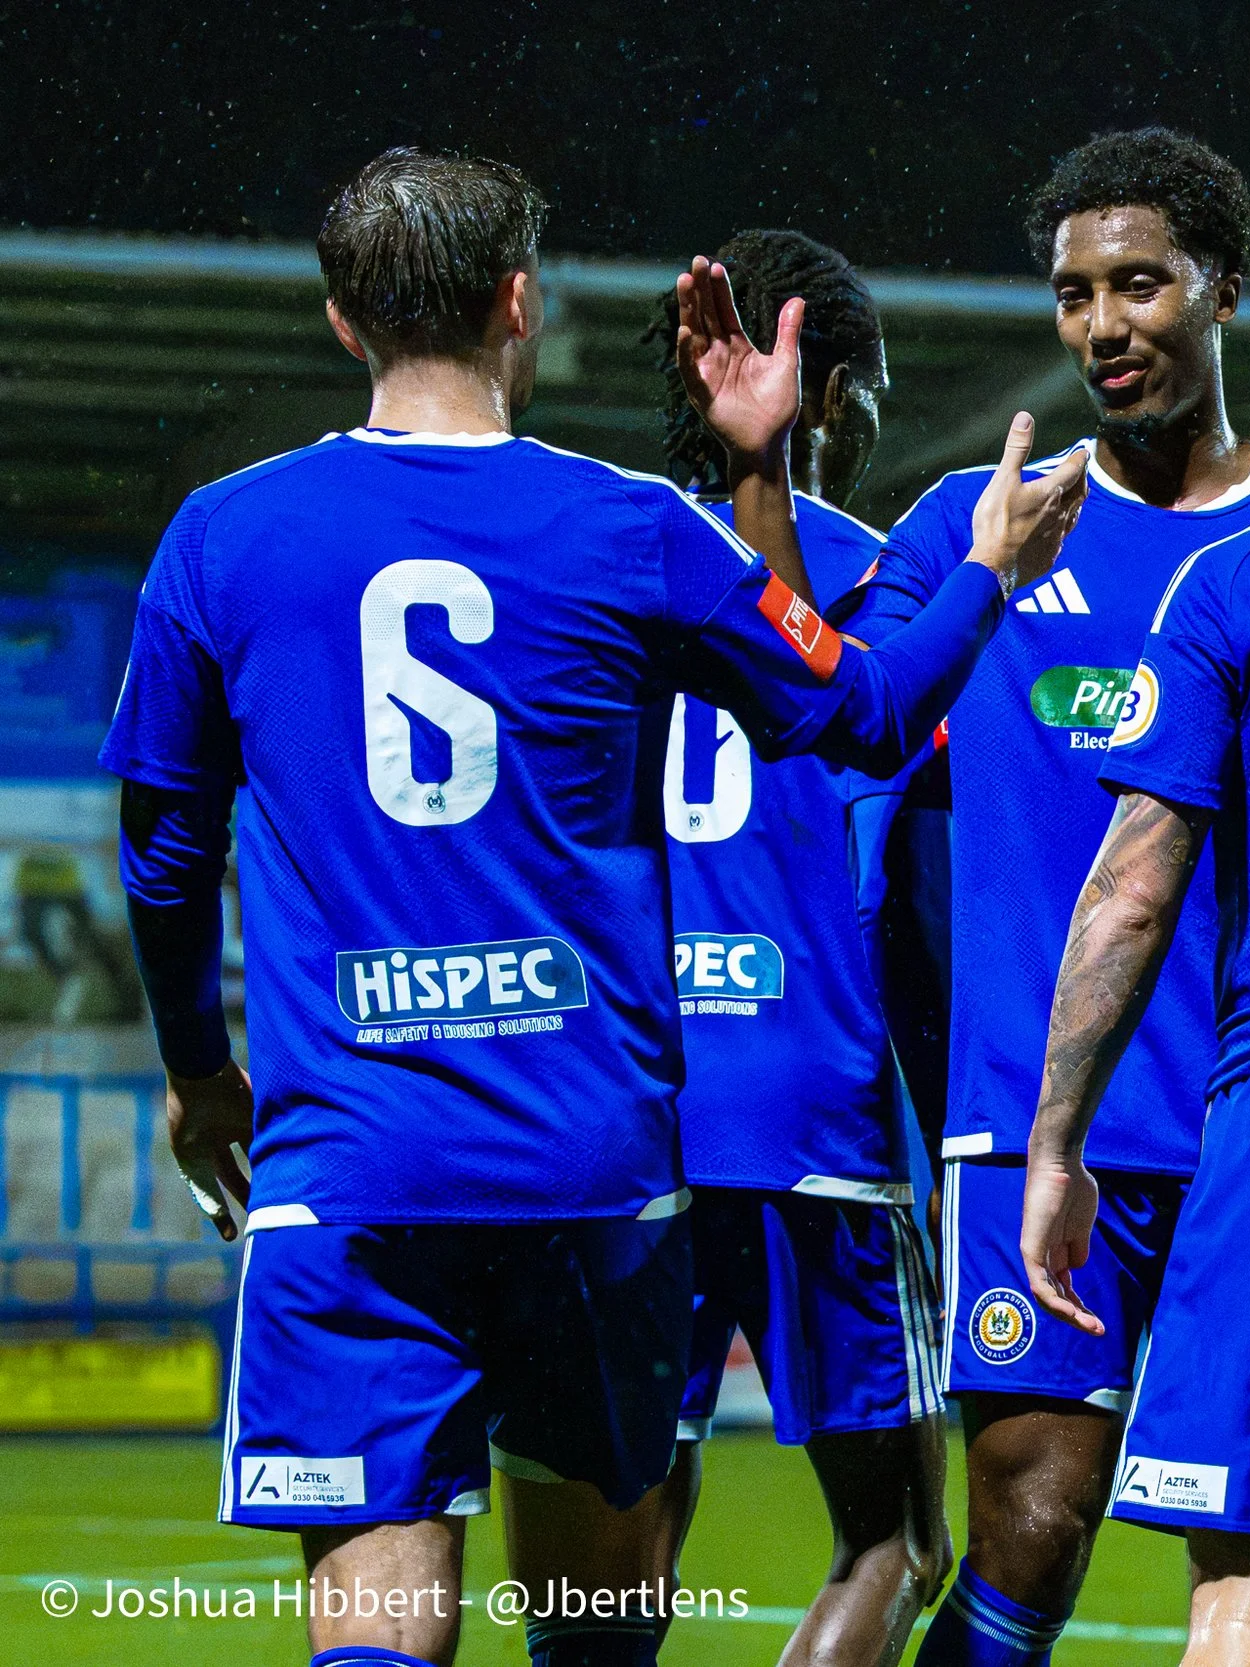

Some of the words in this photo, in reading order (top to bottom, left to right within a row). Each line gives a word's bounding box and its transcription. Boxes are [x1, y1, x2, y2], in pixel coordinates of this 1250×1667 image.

[360, 559, 498, 826] 6
[697, 1000, 758, 1016] SOLUTIONS
[356, 1029, 383, 1043] LIFE
[385, 1025, 429, 1043] SAFETY
[443, 1022, 495, 1039] HOUSING
[498, 1015, 563, 1036] SOLUTIONS
[975, 1293, 1001, 1318] CURZON
[1004, 1293, 1031, 1321] ASHTON
[974, 1335, 1008, 1359] FOOTBALL
[1010, 1336, 1029, 1355] CLUB
[293, 1472, 331, 1484] AZTEK
[1164, 1476, 1198, 1488] AZTEK
